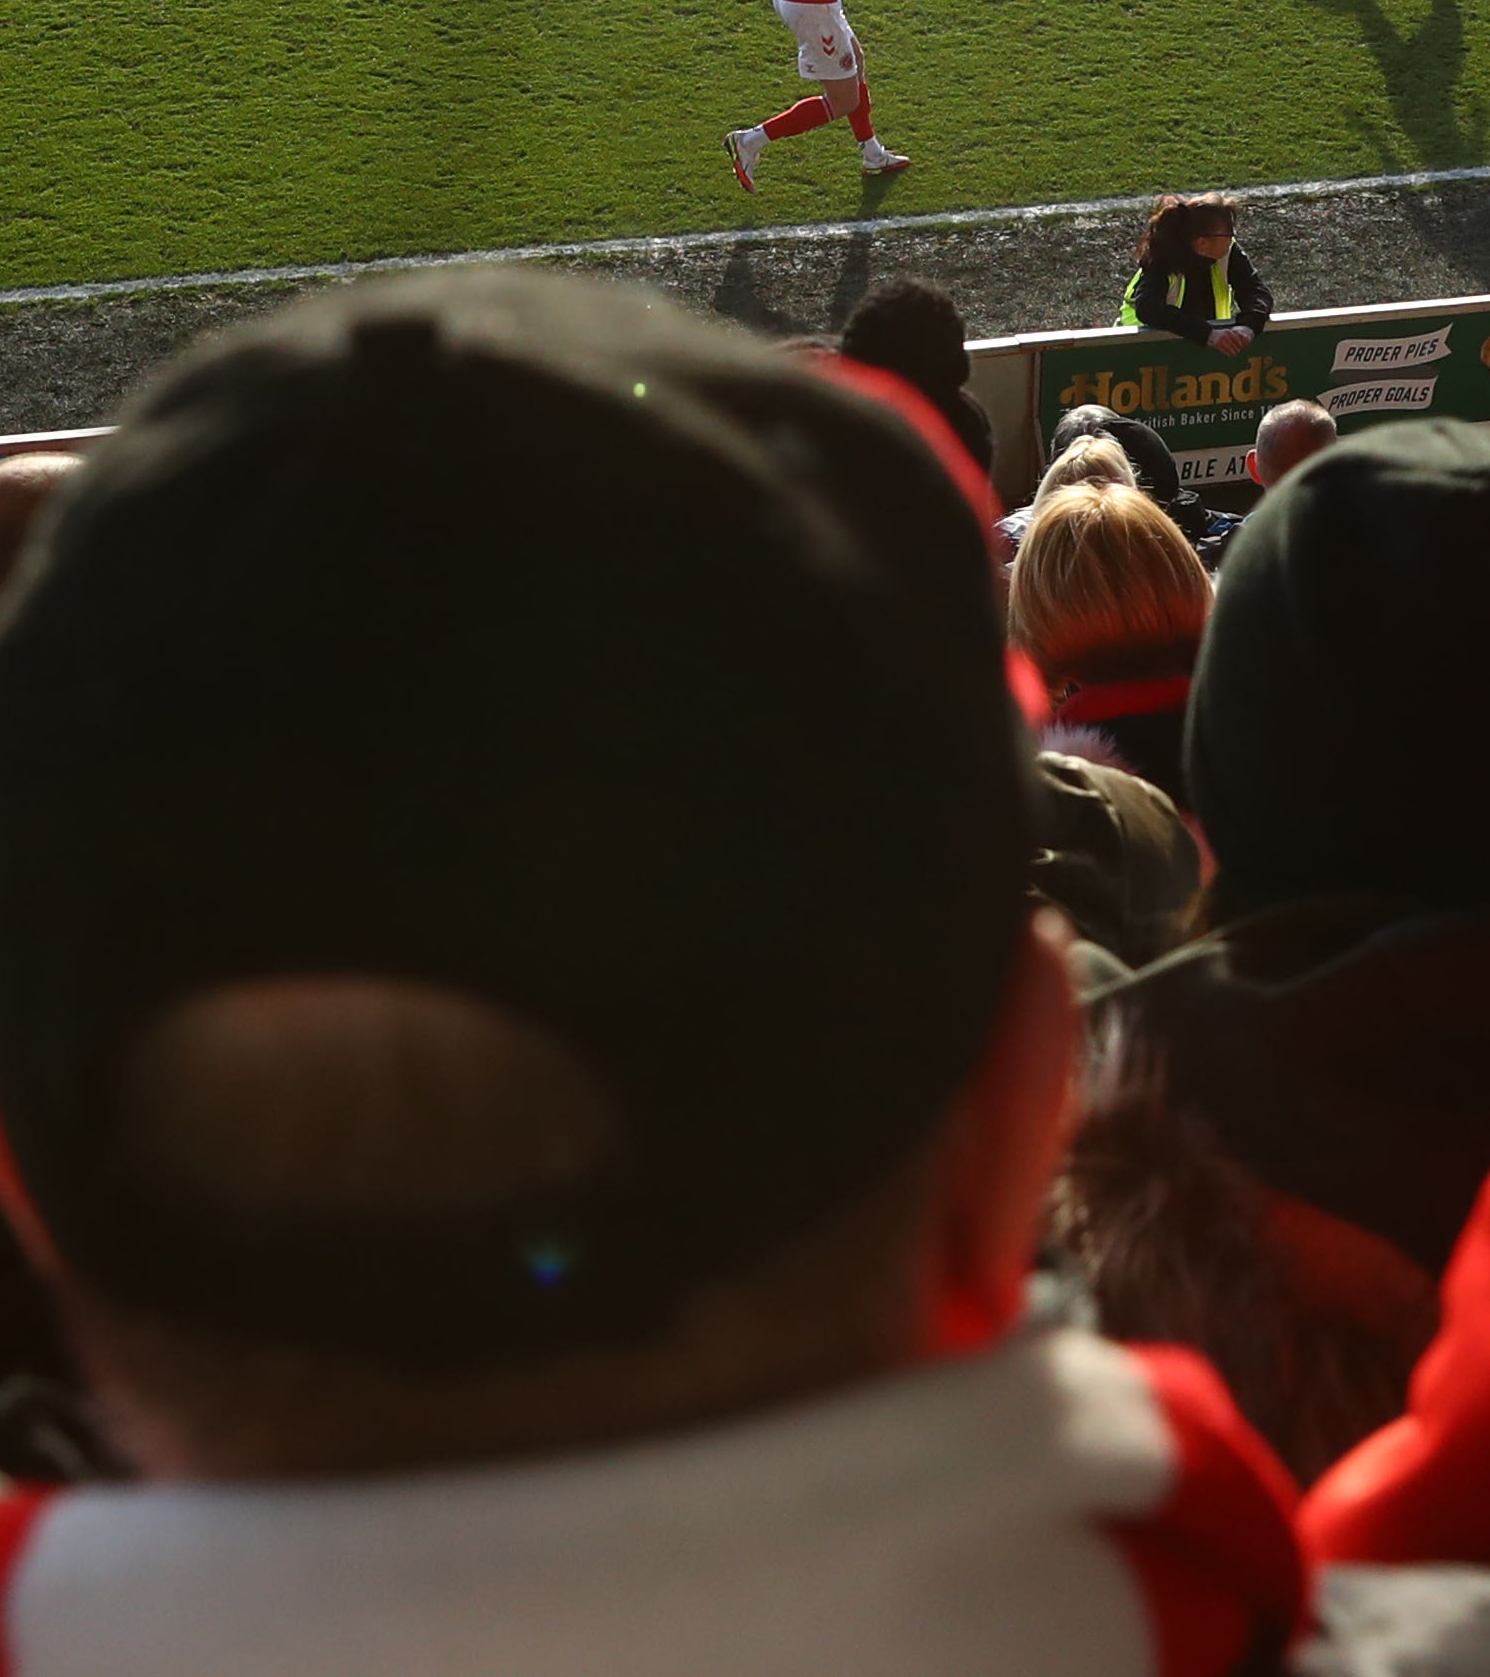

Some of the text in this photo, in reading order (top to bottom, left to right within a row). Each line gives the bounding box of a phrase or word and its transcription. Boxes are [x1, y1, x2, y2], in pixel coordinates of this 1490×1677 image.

[1344, 338, 1439, 363] PROPER PIES
[1059, 354, 1290, 415] Holland's
[1329, 384, 1431, 412] PROPER GOALS
[1180, 412, 1217, 426] Baker
[1221, 408, 1254, 422] Since
[1180, 457, 1218, 481] BLE
